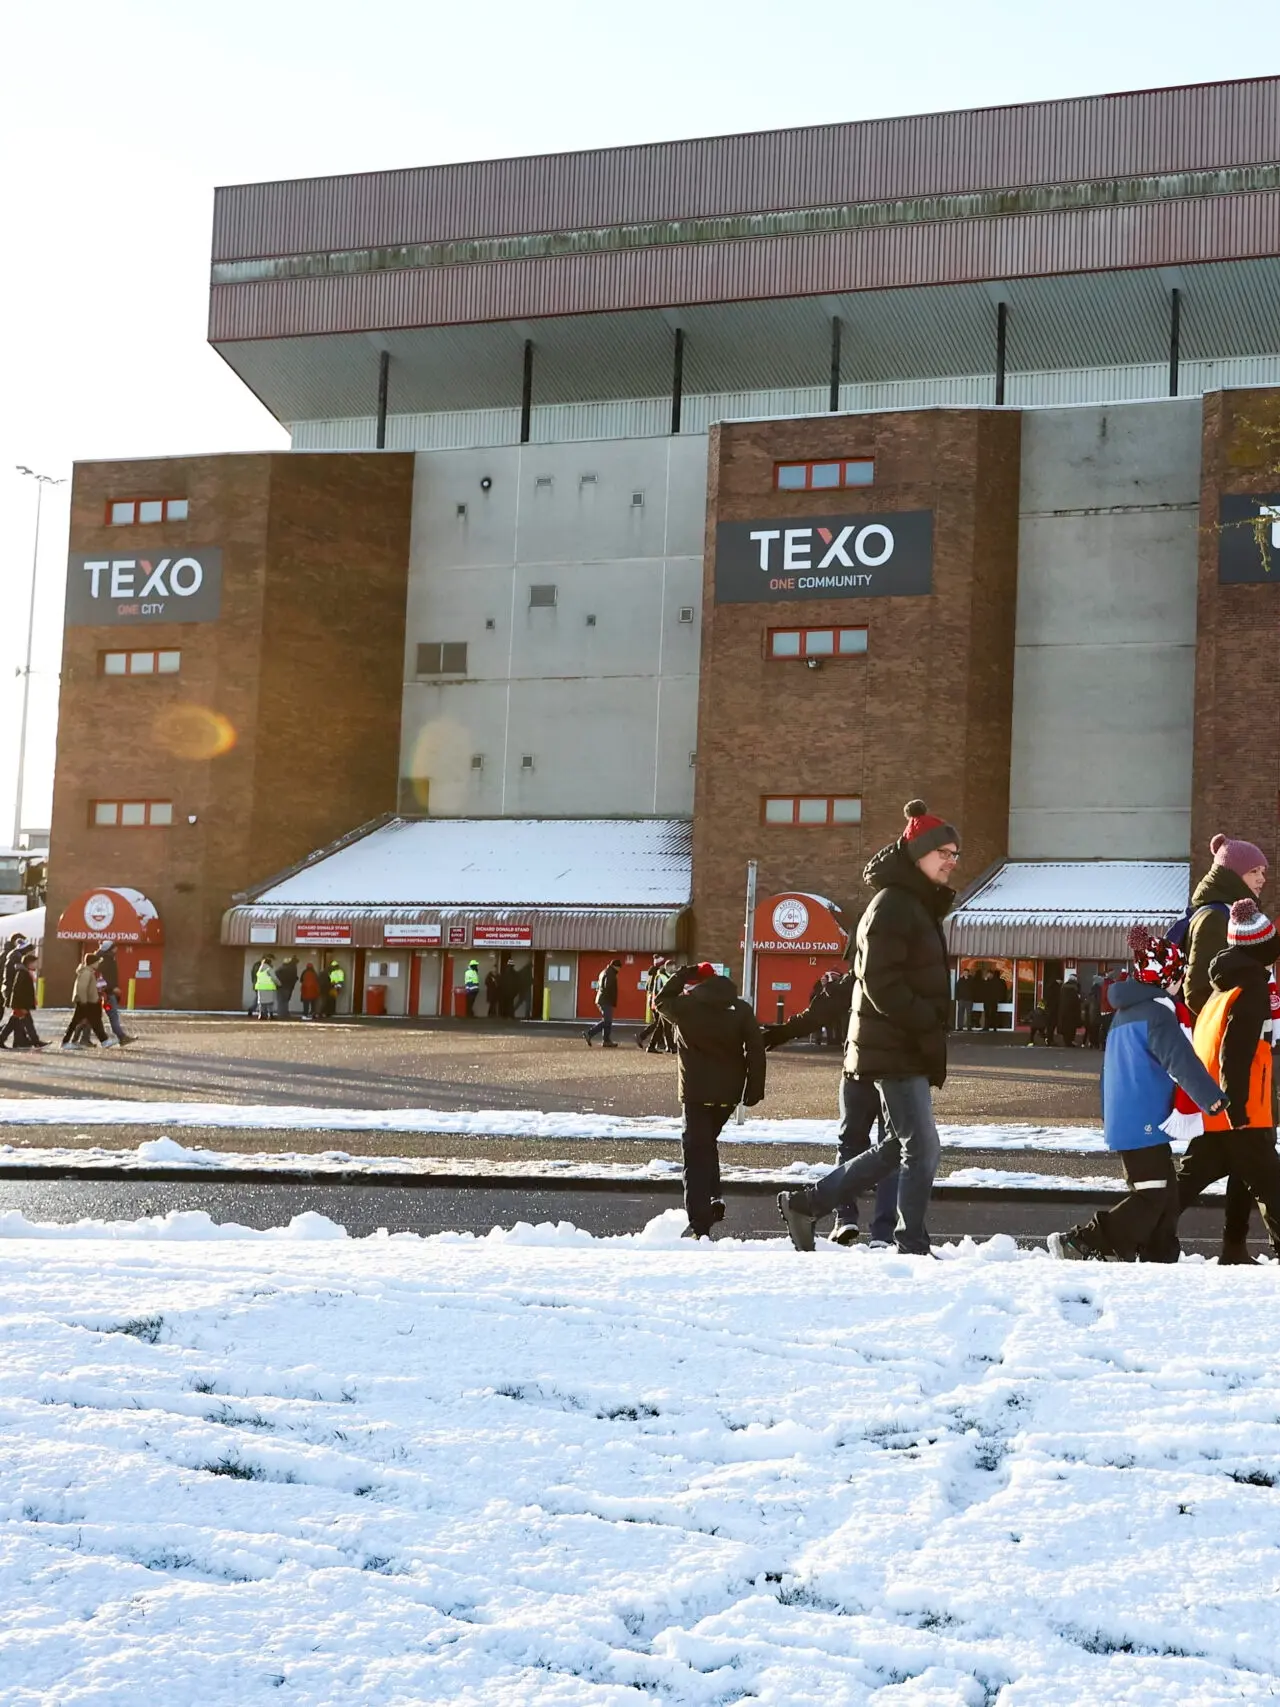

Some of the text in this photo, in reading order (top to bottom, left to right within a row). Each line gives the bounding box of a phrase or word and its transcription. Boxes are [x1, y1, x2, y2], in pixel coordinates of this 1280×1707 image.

[749, 523, 895, 572] TEXO
[83, 557, 204, 599] TEXO
[769, 574, 873, 590] ONE COMMUNITY
[117, 603, 165, 616] ONE CITY
[57, 930, 139, 941] RICHARD DONALD STAND
[740, 940, 839, 951] RHARD DONALD STAND
[809, 956, 817, 966] 12
